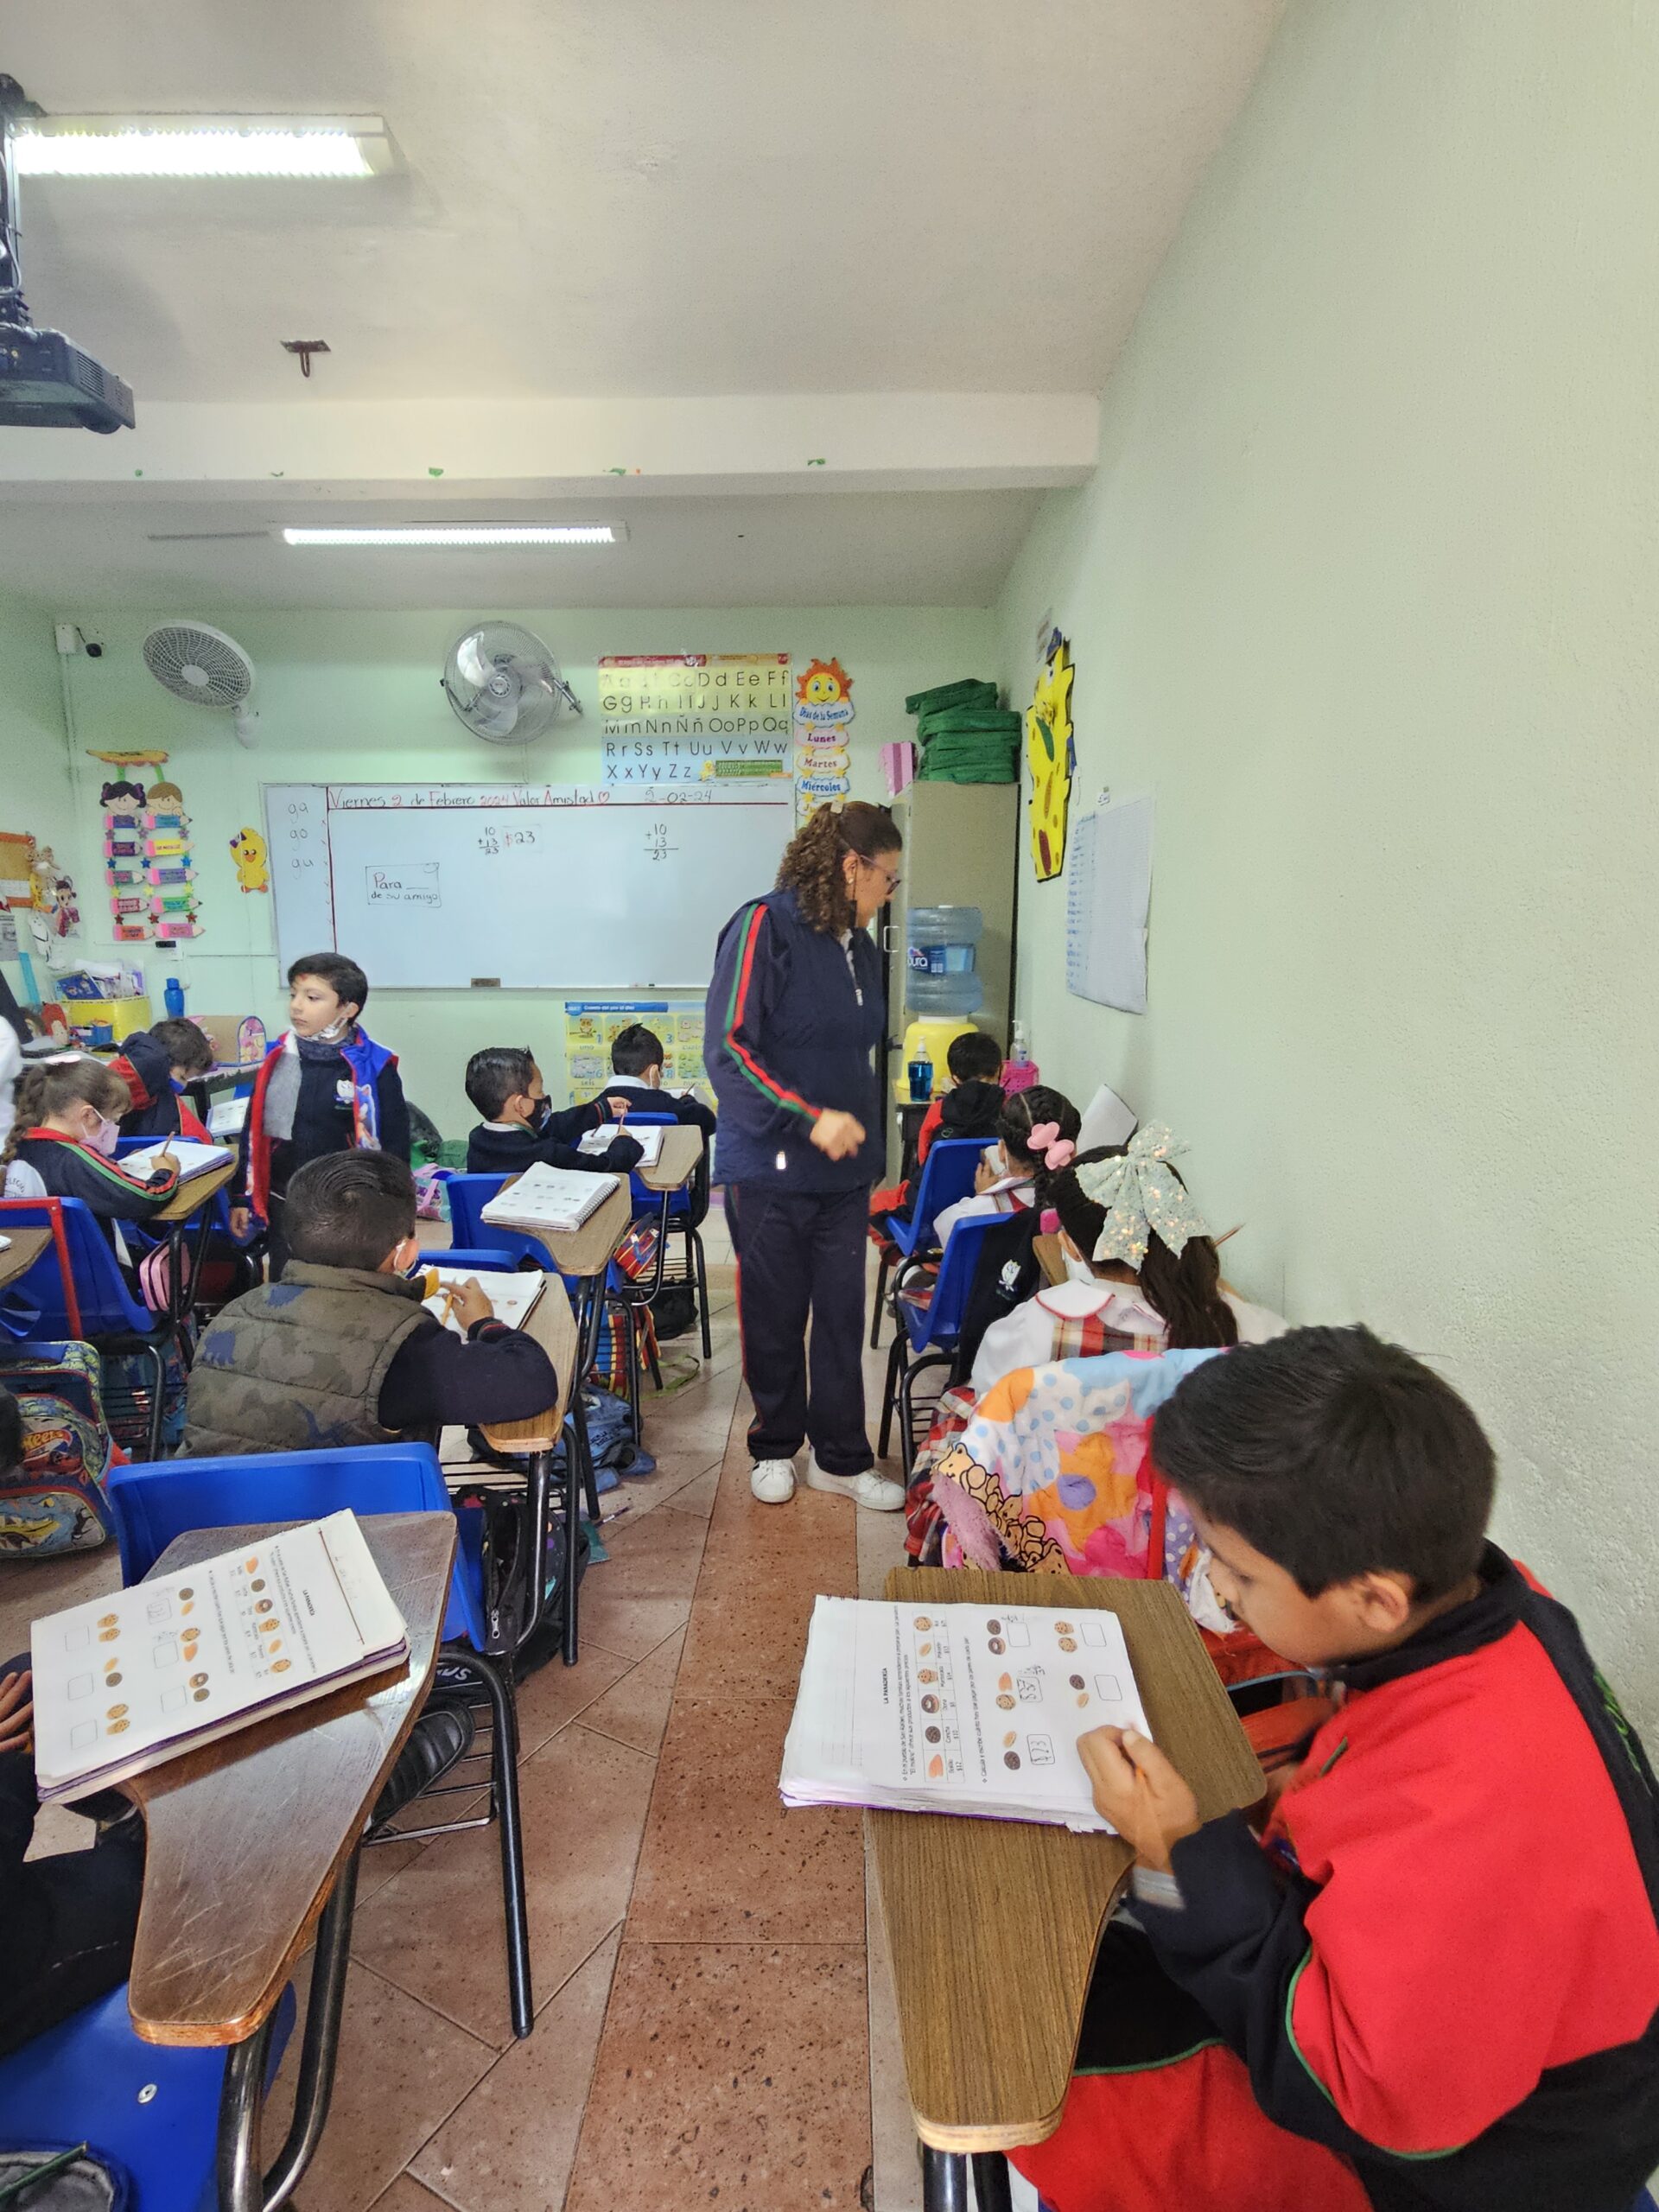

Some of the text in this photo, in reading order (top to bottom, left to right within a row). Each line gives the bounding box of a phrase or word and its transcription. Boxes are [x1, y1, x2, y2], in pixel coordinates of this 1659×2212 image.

[807, 733, 836, 743] Lunes
[804, 758, 837, 768] Martes
[801, 779, 841, 792] Miércoles
[329, 788, 386, 808] Viernes
[429, 791, 475, 806] Febrero
[544, 789, 594, 805] Amistad
[373, 871, 403, 889] Para
